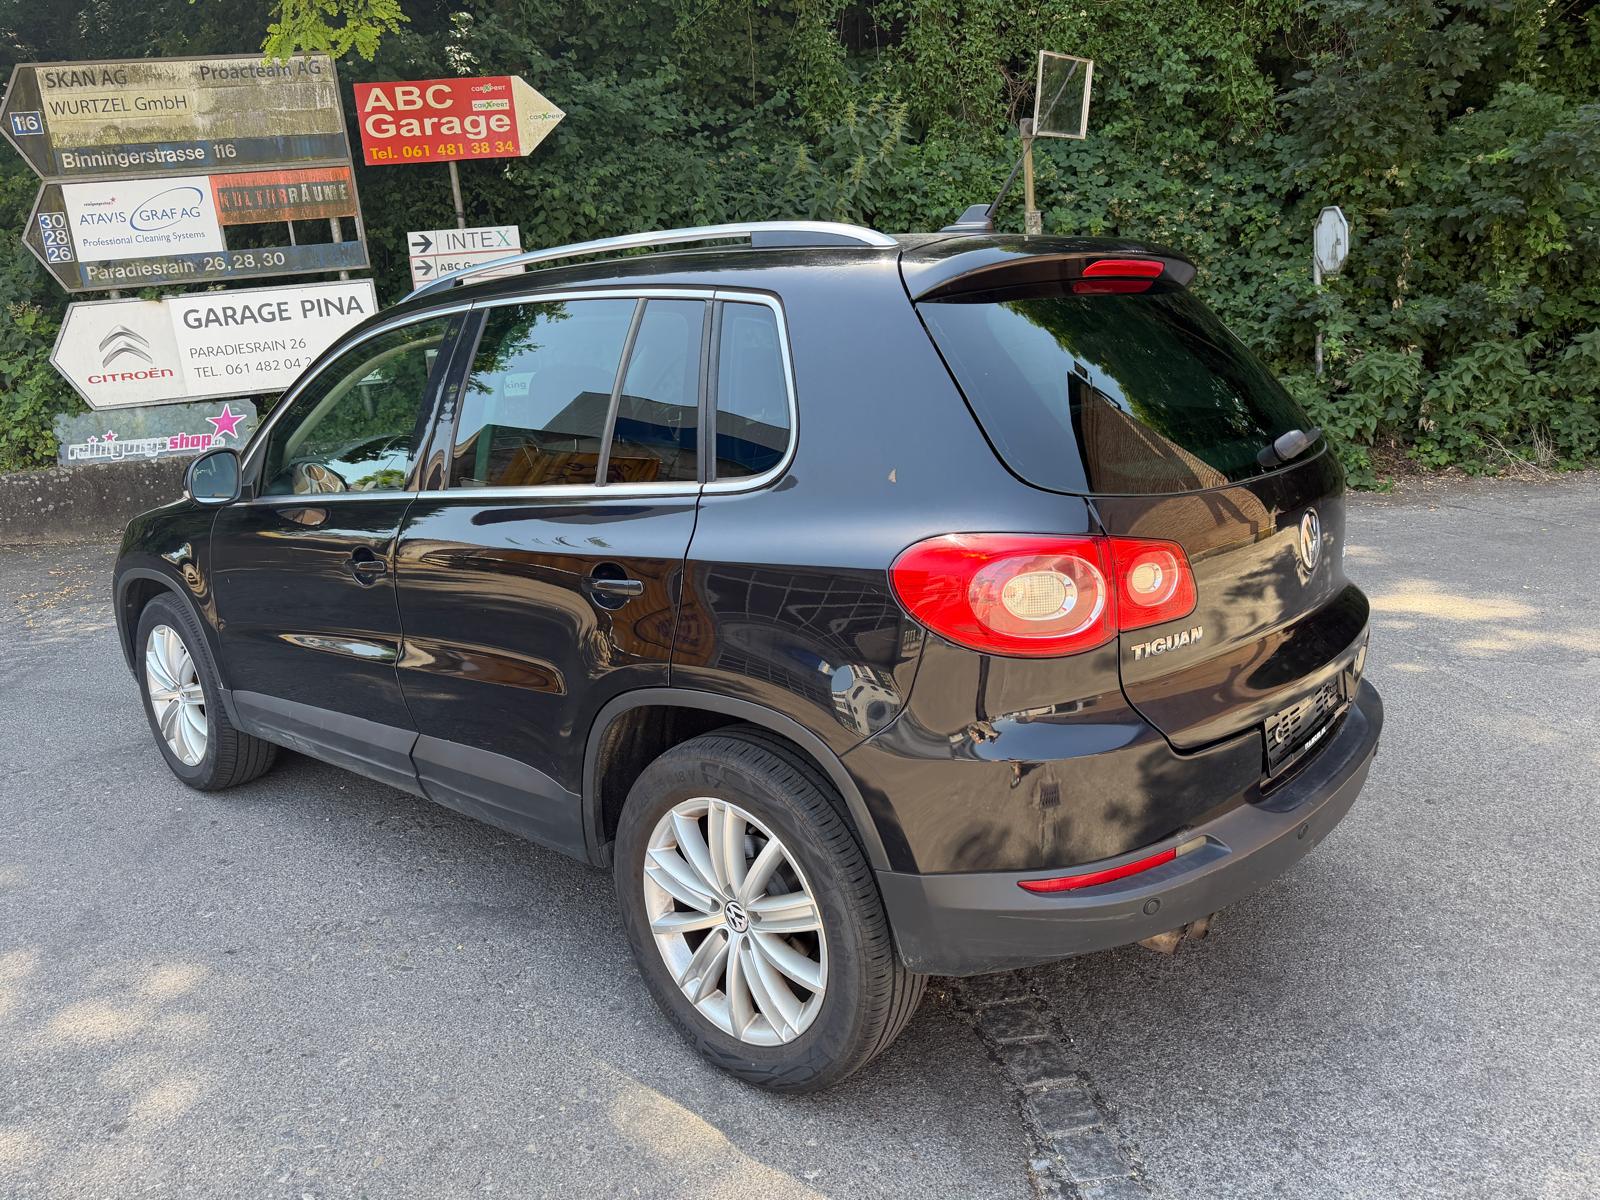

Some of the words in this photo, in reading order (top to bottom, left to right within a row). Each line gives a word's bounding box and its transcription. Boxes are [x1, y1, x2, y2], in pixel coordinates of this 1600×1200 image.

[45, 70, 96, 88] SKAN
[102, 69, 127, 86] AG
[199, 63, 292, 80] Proacteam
[298, 60, 321, 75] AG
[48, 97, 131, 116] WURTZEL
[134, 95, 188, 112] GmbH
[364, 84, 454, 113] ABC
[14, 115, 38, 131] 116
[365, 114, 511, 140] Garage
[61, 147, 205, 169] Binningerstrasse
[213, 144, 237, 159] 116
[370, 147, 398, 160] Tel.
[402, 145, 430, 158] 061
[437, 143, 465, 156] 481
[471, 142, 490, 154] 38
[495, 140, 513, 153] 34
[40, 215, 65, 229] 30
[139, 209, 177, 221] GRAF
[181, 207, 201, 218] AG
[44, 230, 67, 246] 28
[83, 235, 133, 247] Professional
[135, 233, 171, 243] Cleaning
[172, 231, 206, 240] Systems
[446, 230, 512, 250] INTEX
[48, 247, 71, 262] 26
[86, 260, 195, 281] Paradiesrain
[440, 263, 460, 272] ABC
[183, 302, 292, 330] GARAGE
[301, 295, 364, 319] PINA
[190, 339, 286, 359] PARADIESRAIN
[290, 338, 306, 350] 26
[194, 366, 222, 378] TEL.
[226, 363, 250, 376] 061
[255, 360, 281, 372] 482
[284, 357, 302, 370] 04
[1130, 625, 1203, 661] TIGUAN
